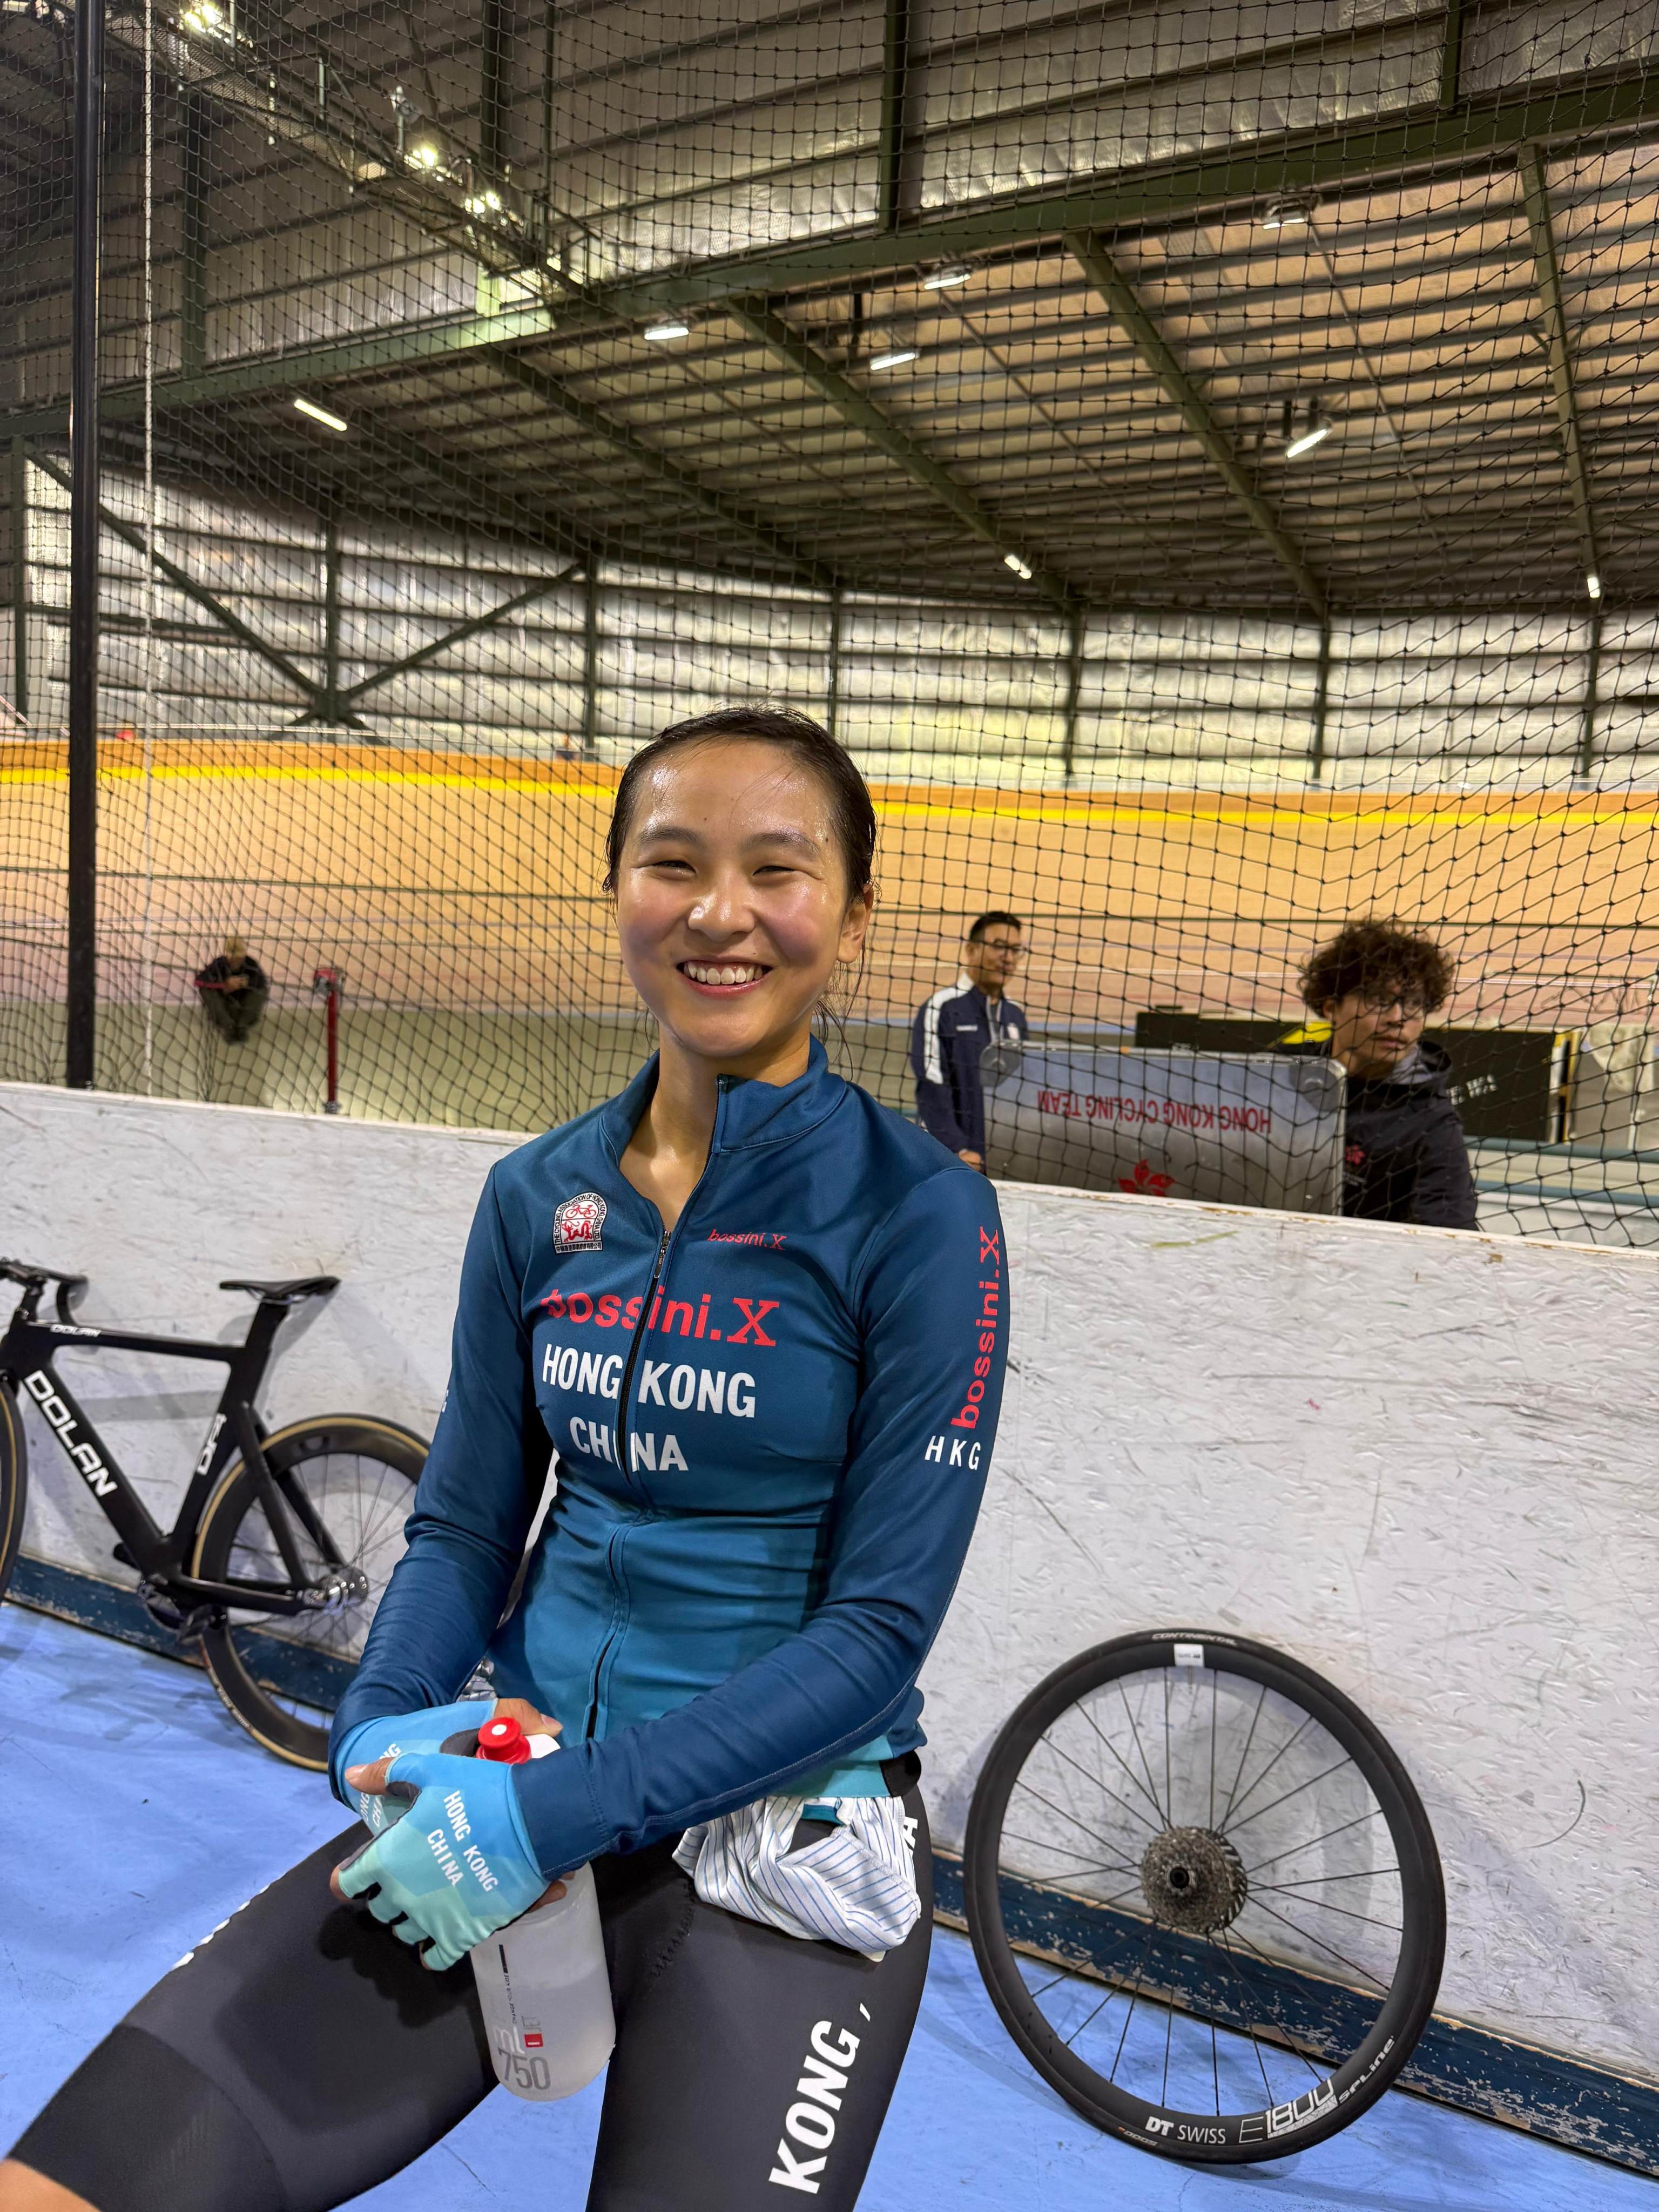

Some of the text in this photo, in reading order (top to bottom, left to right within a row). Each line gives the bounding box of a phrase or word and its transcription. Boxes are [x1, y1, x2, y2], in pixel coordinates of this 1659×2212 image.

[1037, 1090, 1272, 1134] HONG KONG CYCLING TEAM
[707, 1228, 786, 1251] bossini.X
[541, 1285, 780, 1347] bossini.X
[950, 1226, 1000, 1429] bossini.X
[542, 1343, 756, 1418] HONG KONG
[24, 1370, 118, 1496] DOLAN
[570, 1416, 689, 1473] CHINA
[1151, 1631, 1238, 1647] CONTINENTAL
[427, 1828, 463, 1887] CHINA
[442, 1790, 499, 1893] HONG KONG
[497, 2046, 551, 2090] 750
[1145, 2116, 1175, 2136] DT
[1177, 2125, 1226, 2144] SWISS
